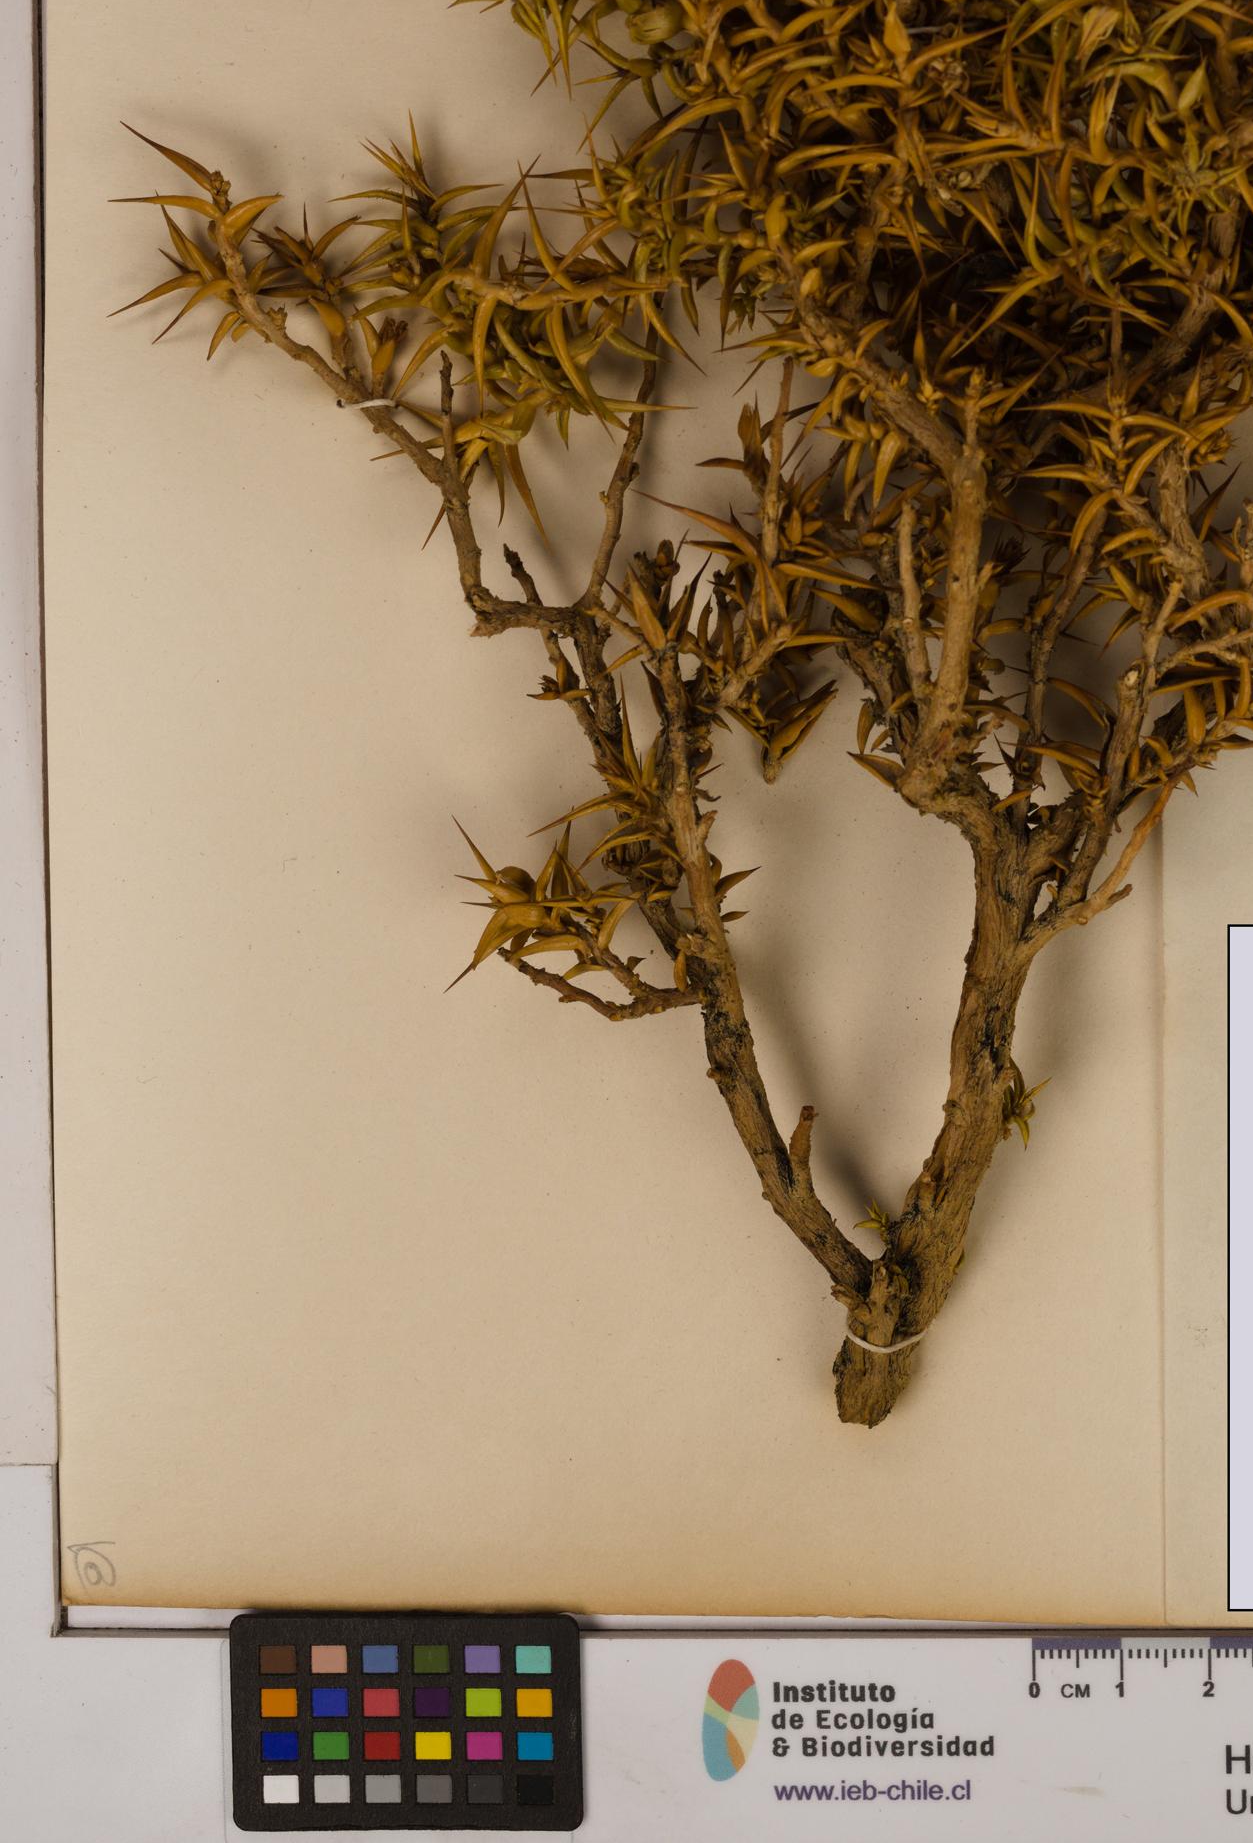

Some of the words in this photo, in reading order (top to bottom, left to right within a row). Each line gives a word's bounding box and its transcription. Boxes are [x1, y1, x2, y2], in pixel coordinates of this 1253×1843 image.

[773, 1680, 896, 1704] Instituto
[1028, 1681, 1041, 1700] 0
[1060, 1684, 1091, 1700] CM
[1115, 1680, 1125, 1699] 1
[1202, 1680, 1215, 1699] 2
[770, 1708, 805, 1731] de
[815, 1707, 935, 1735] Ecología
[771, 1736, 791, 1758] &
[800, 1734, 996, 1758] Biodiversidad
[773, 1780, 971, 1802] www.ieb-chile.cl
